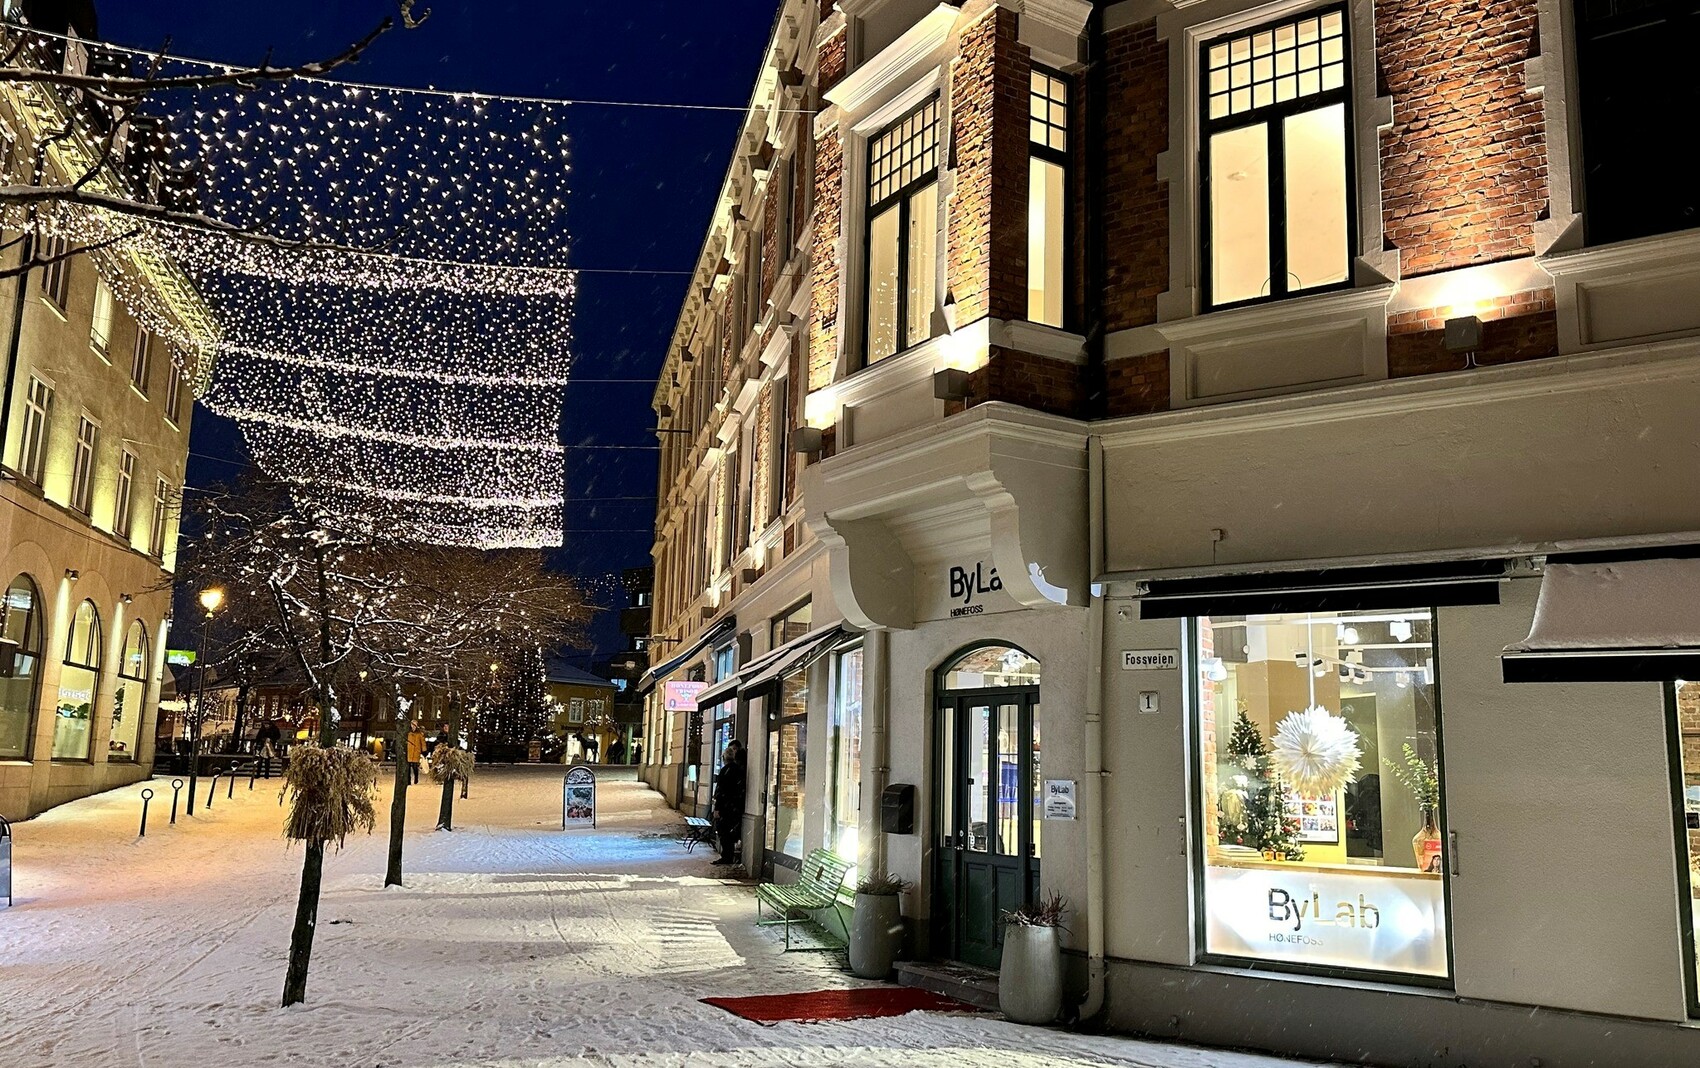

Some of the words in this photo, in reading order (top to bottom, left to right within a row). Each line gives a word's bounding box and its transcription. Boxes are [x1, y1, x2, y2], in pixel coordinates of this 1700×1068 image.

[950, 562, 1003, 604] ByLa
[950, 605, 984, 617] HØNEFOSS
[1125, 653, 1174, 665] Fossveien
[1145, 694, 1152, 709] 1
[1051, 784, 1070, 795] ByLab
[1268, 887, 1380, 931] ByLab
[1268, 932, 1324, 946] HØNEFOSS
